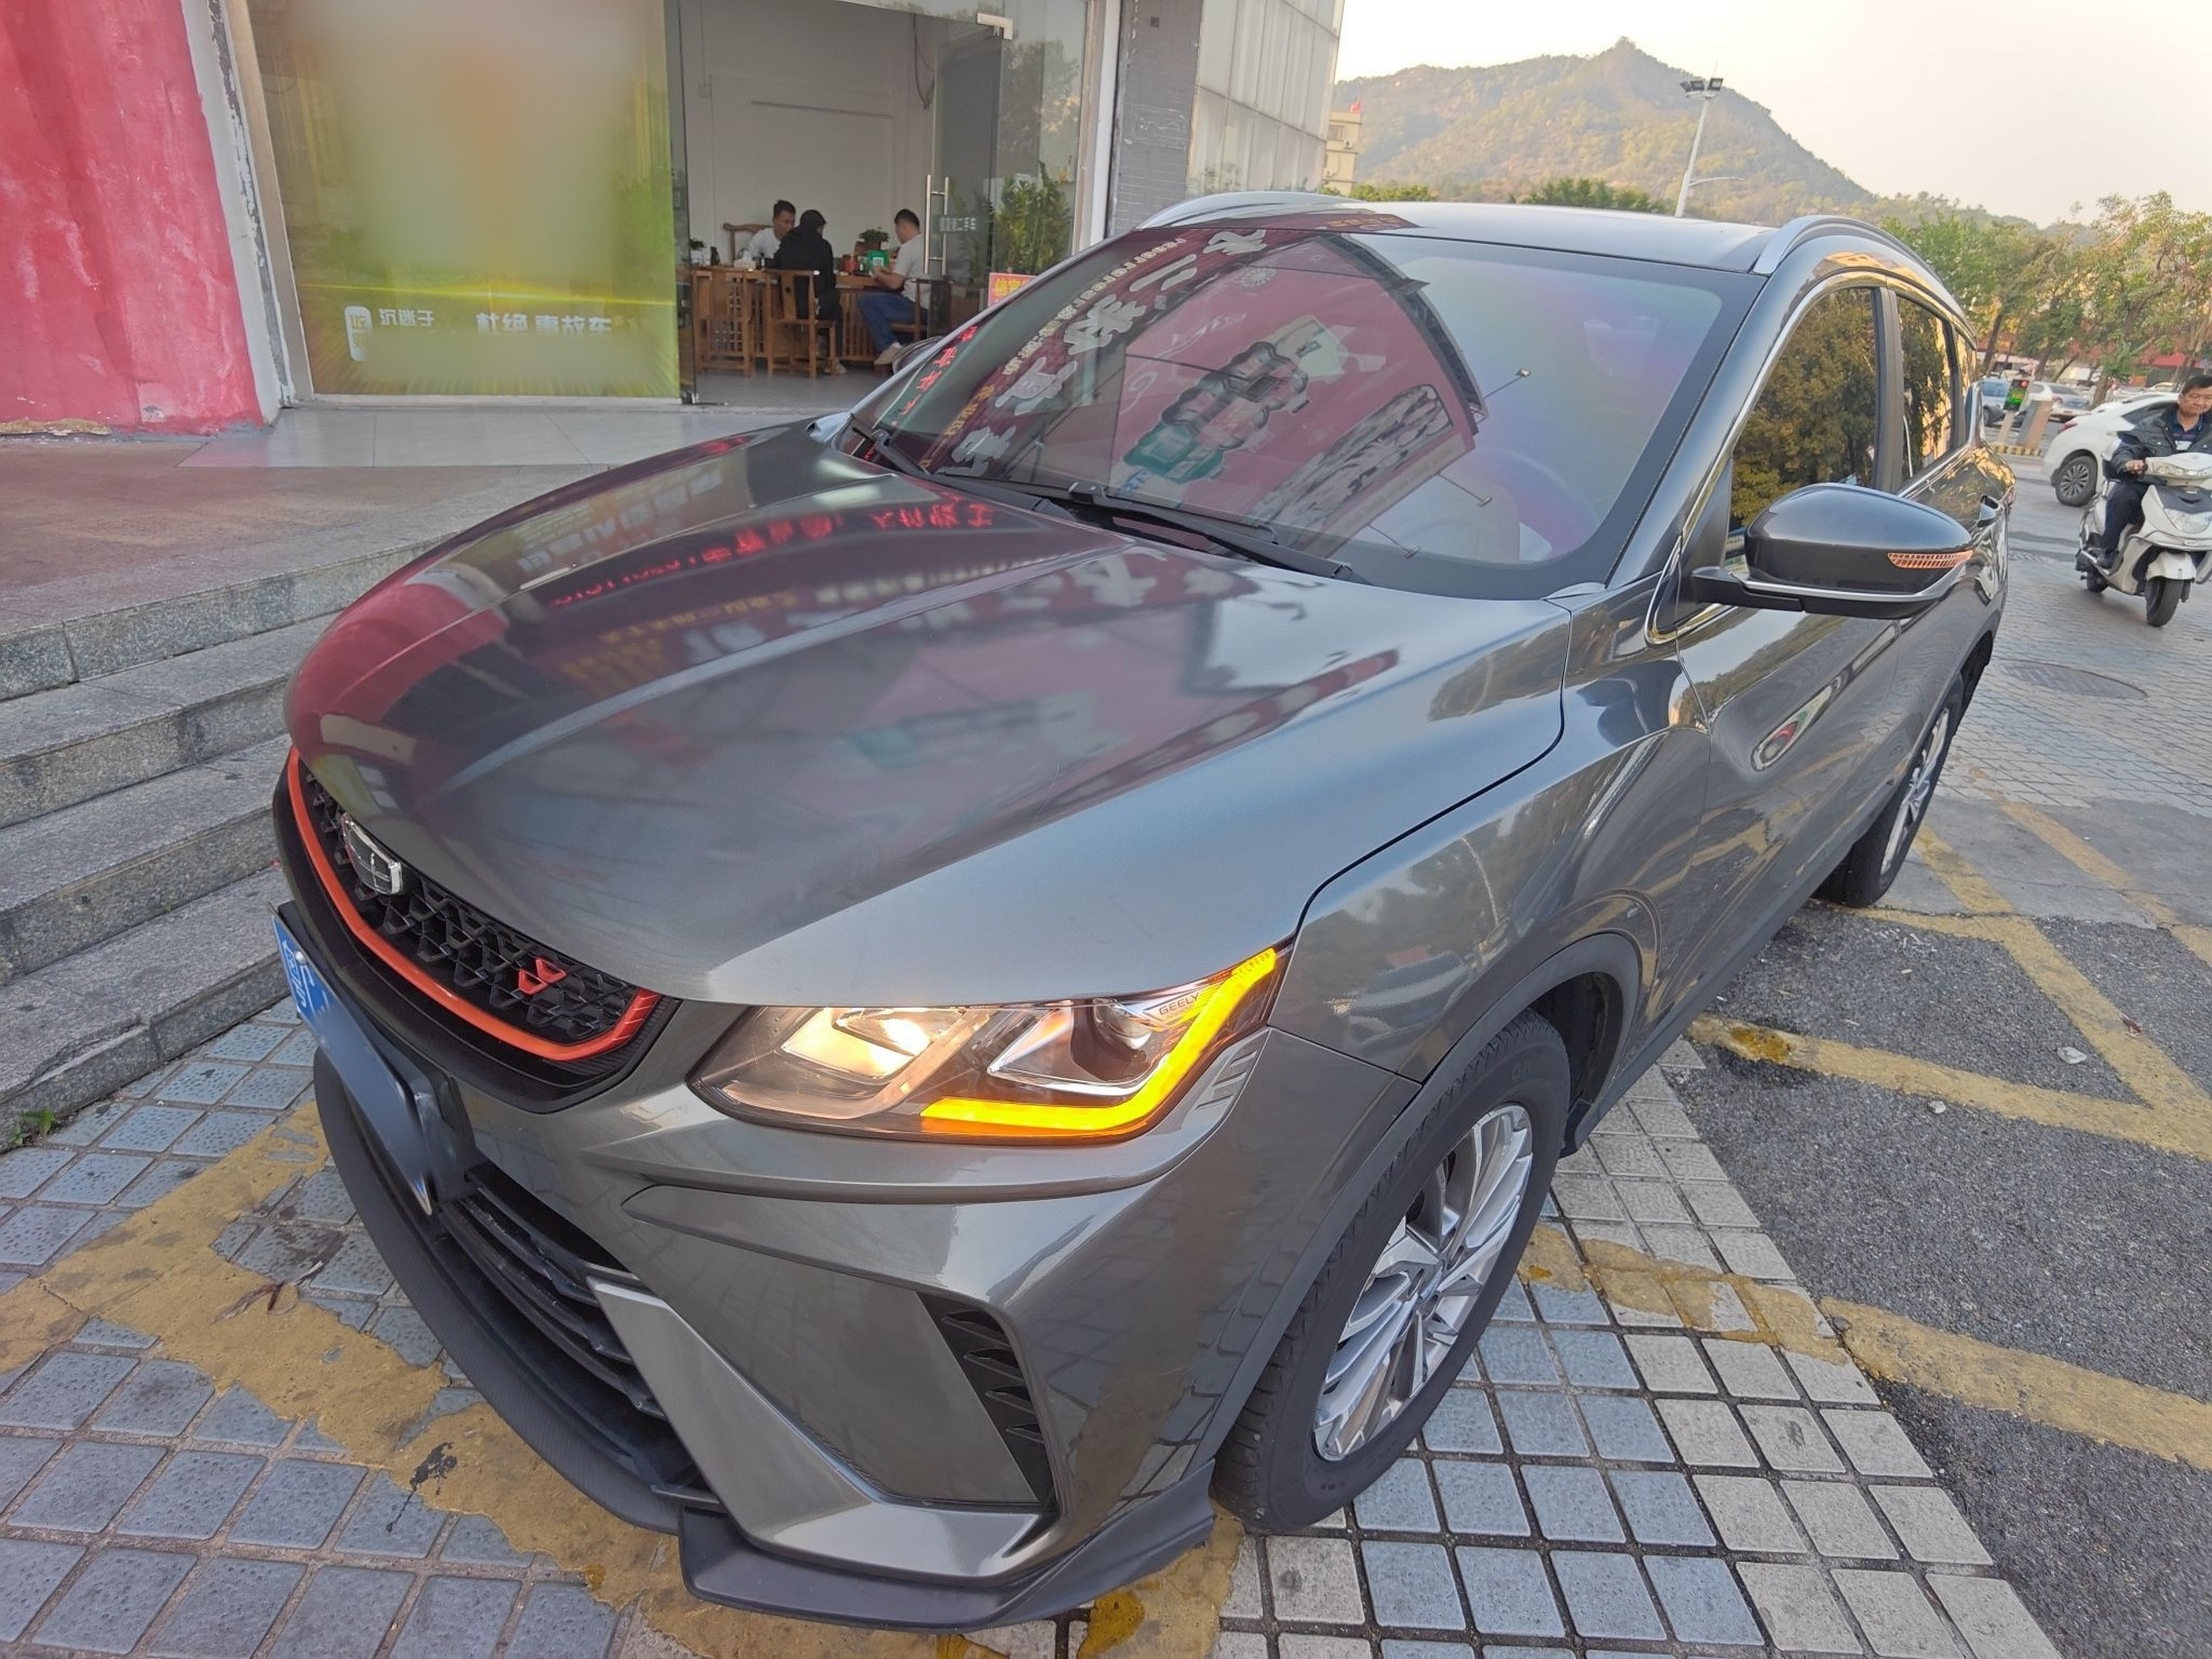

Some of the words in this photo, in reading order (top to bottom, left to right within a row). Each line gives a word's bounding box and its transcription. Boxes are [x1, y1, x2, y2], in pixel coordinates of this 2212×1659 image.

[378, 308, 435, 327] 沉迷于
[1158, 991, 1199, 1016] GEELY
